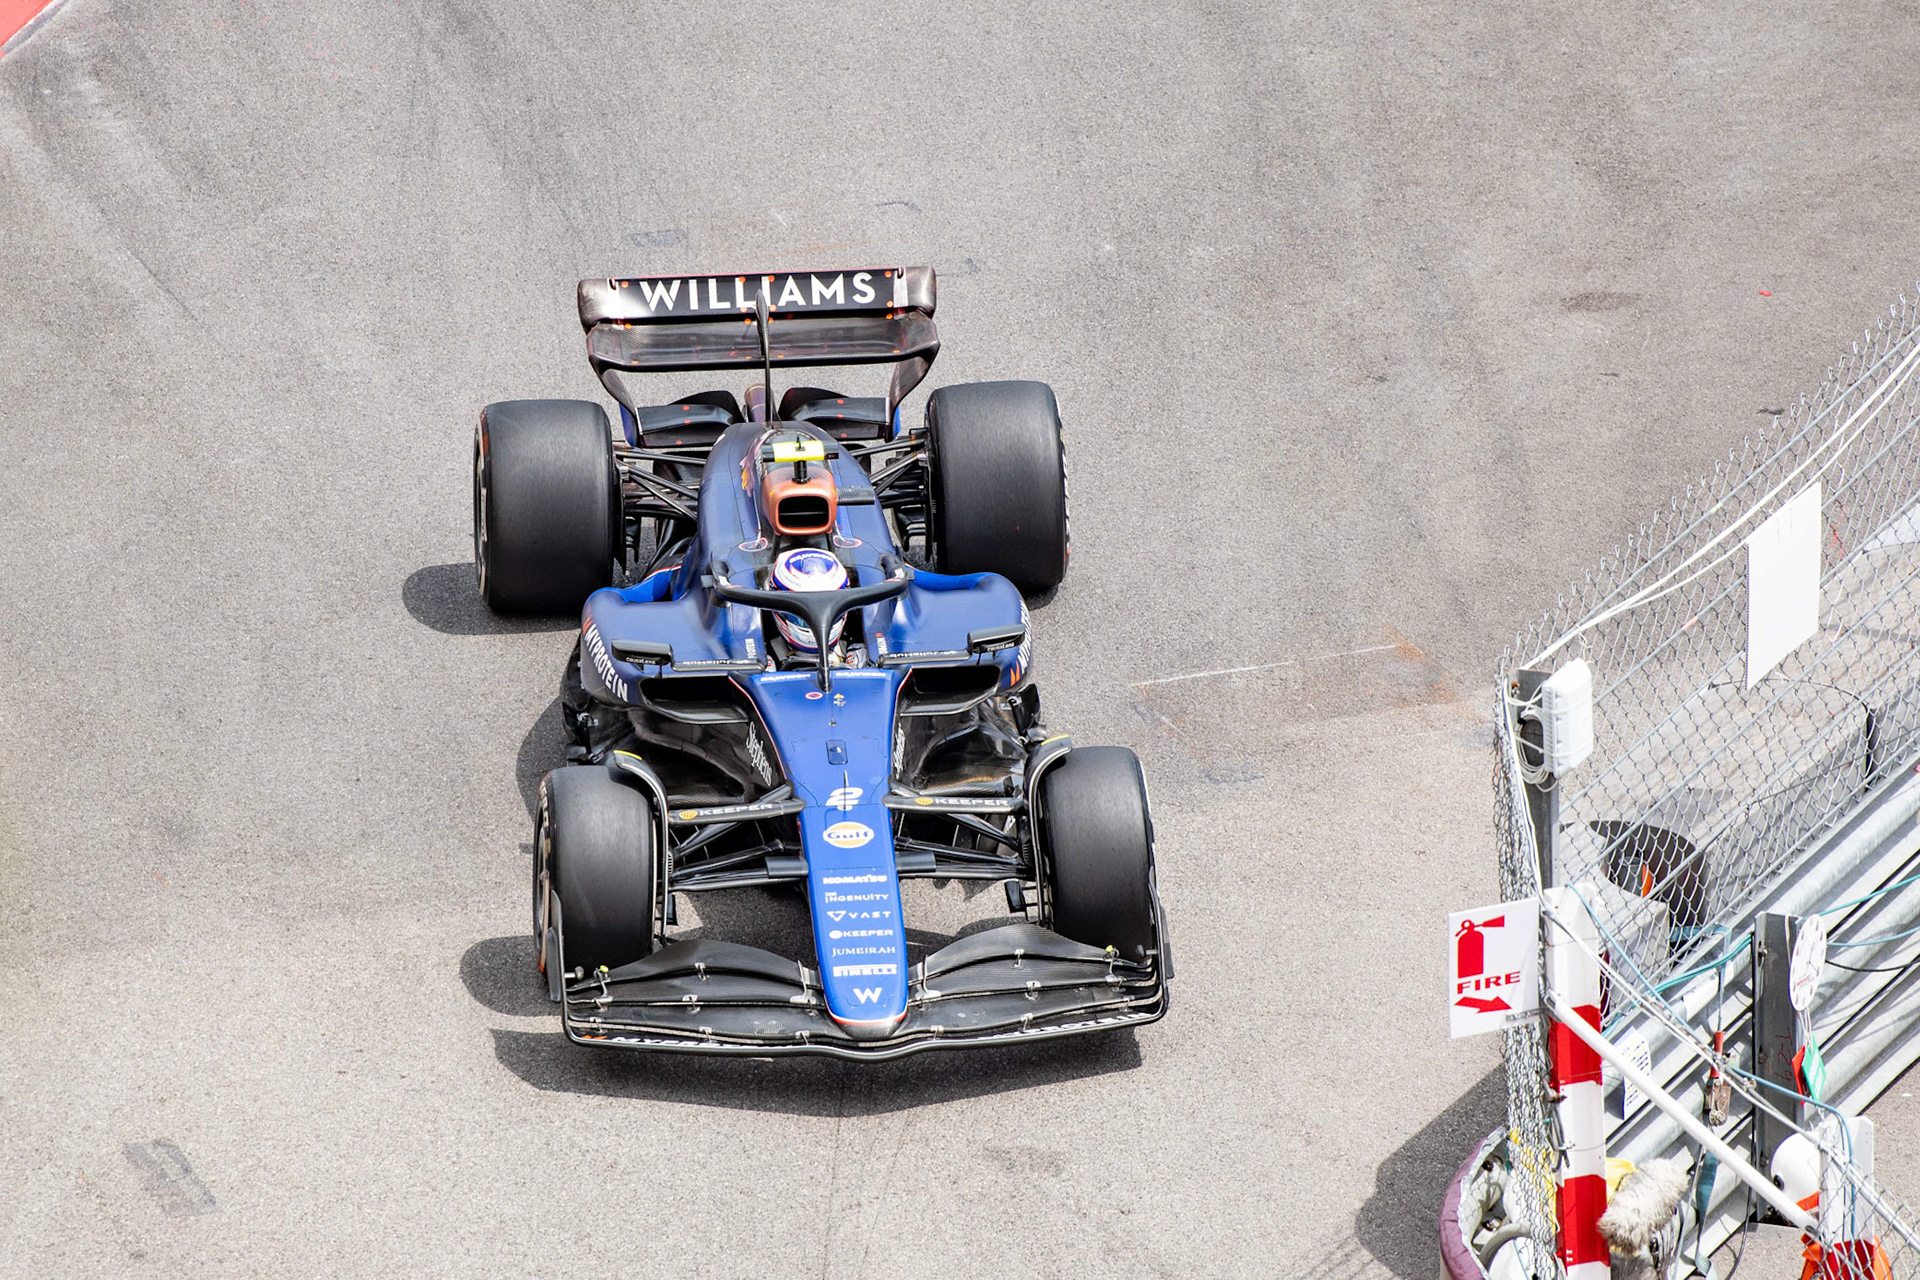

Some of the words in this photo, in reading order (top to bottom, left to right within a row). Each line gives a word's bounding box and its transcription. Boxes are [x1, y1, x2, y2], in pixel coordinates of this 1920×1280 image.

[639, 273, 876, 312] WILLIAMS
[584, 623, 628, 703] MYPROTEIN
[935, 798, 1009, 806] KEEPER
[699, 803, 773, 816] KEEPER
[827, 830, 872, 841] Gulf
[848, 910, 892, 919] VAST
[843, 929, 894, 937] KEEPER
[832, 946, 896, 957] JUMEIRAH
[1457, 970, 1521, 995] FIRE
[853, 987, 882, 1005] W
